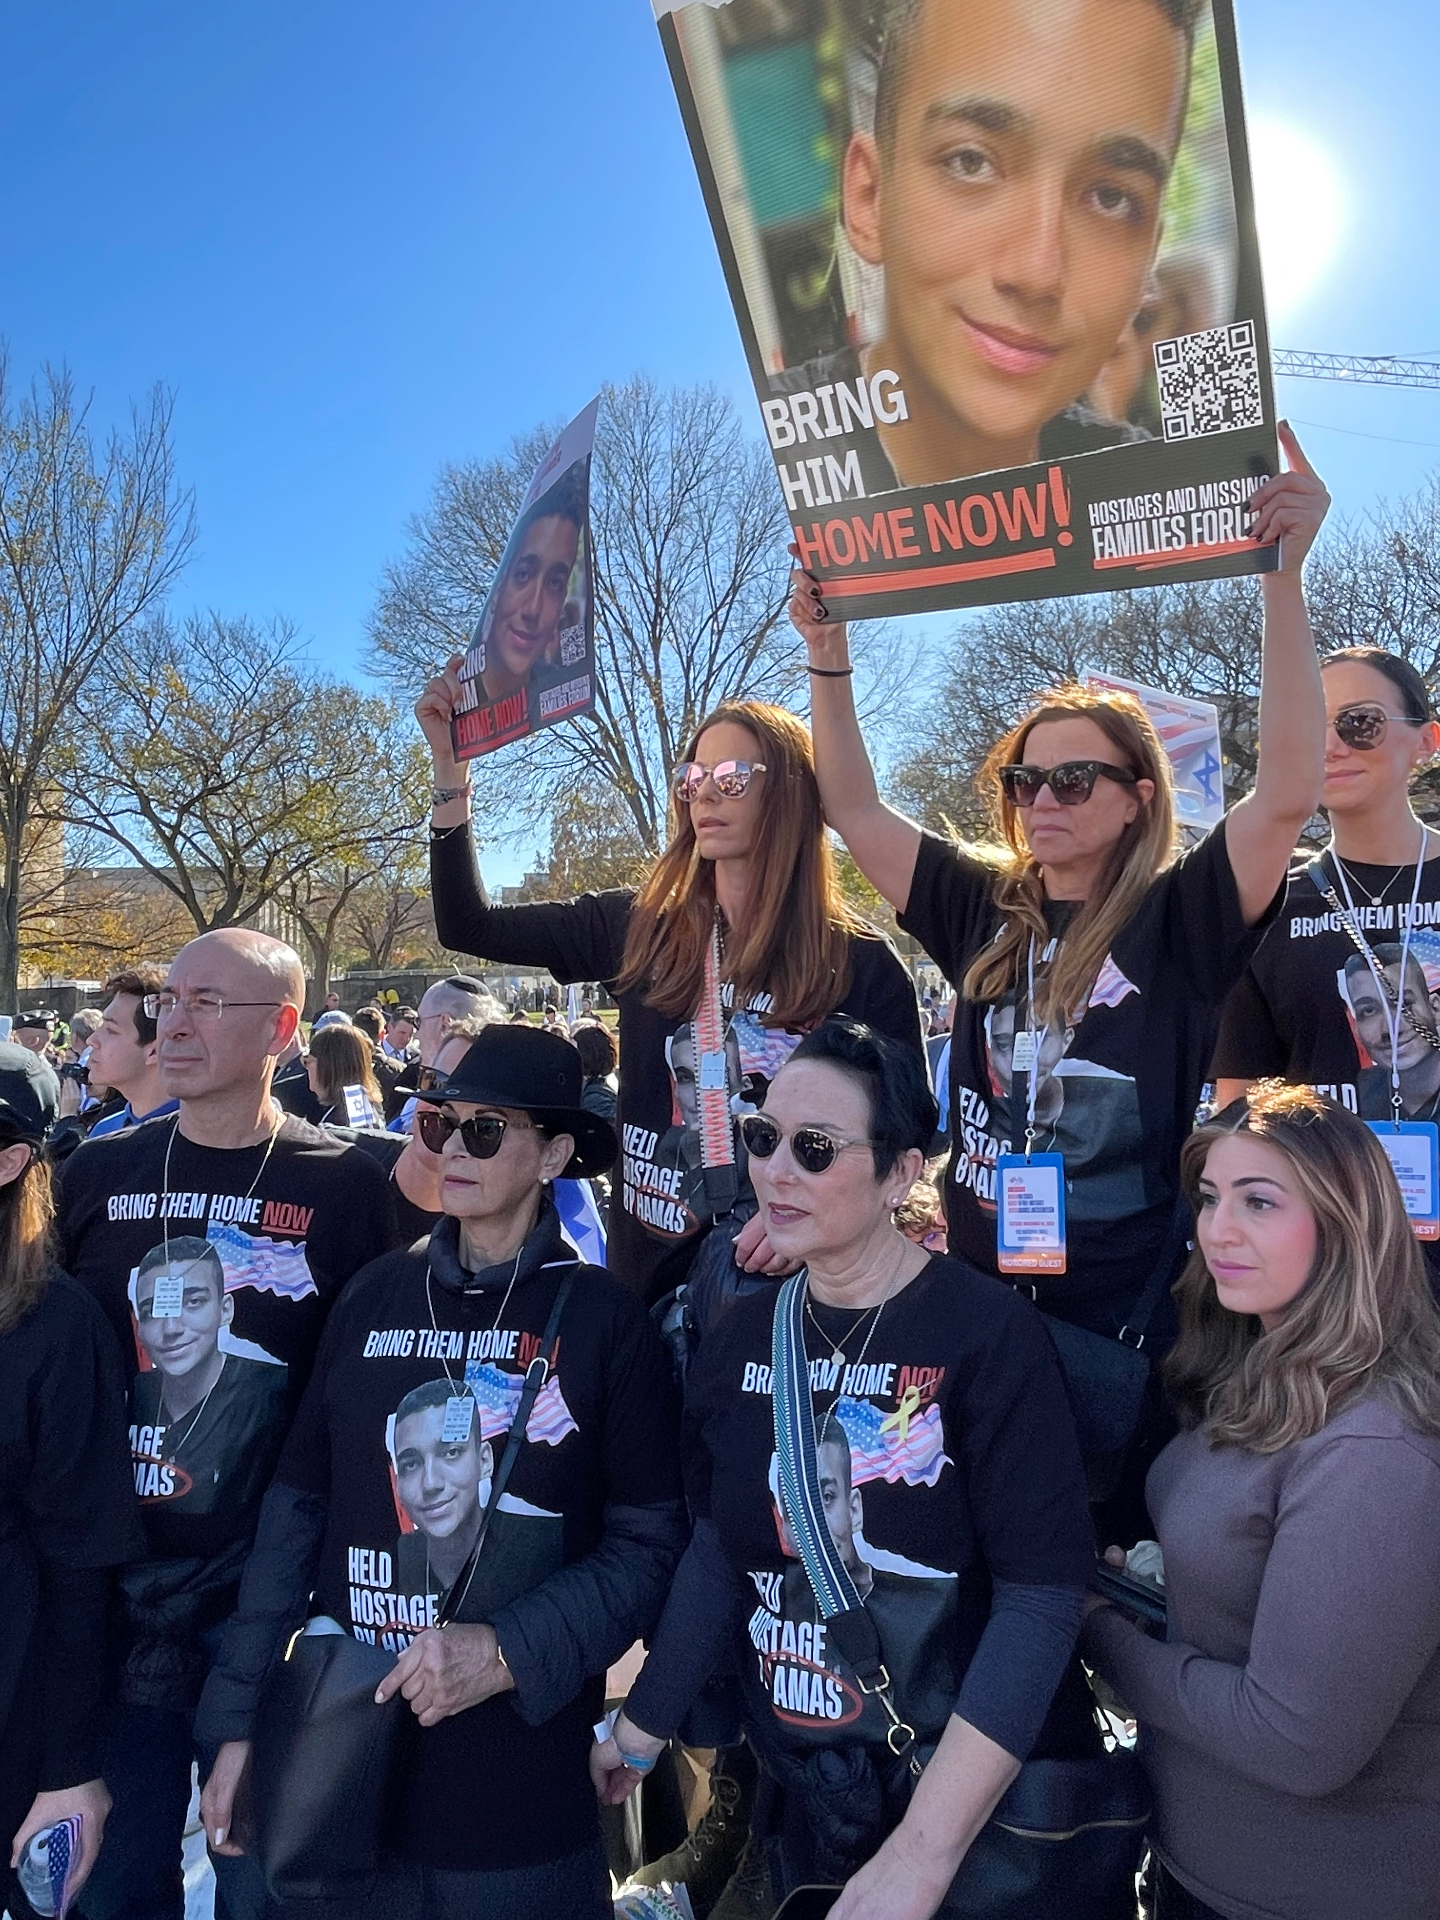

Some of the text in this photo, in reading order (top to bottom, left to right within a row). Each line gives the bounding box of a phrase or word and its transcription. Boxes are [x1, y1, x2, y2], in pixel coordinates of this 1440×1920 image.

[761, 369, 909, 450] BRING
[778, 449, 866, 511] HIM
[795, 466, 1073, 570] HOME NOW!
[1088, 492, 1163, 527] HOSTAGES
[1165, 486, 1197, 515] AND
[1092, 505, 1261, 561] FAMILIES FORU
[457, 643, 486, 682] RING
[455, 679, 479, 716] IM
[456, 686, 529, 746] HOME NOW!
[541, 685, 590, 717] FAMILIES FORUM
[1290, 902, 1440, 939] BRING HEM HOM
[959, 1085, 989, 1129] ELD
[622, 1123, 659, 1161] HELD
[623, 1153, 684, 1200] HOSTAGE
[107, 1192, 315, 1231] BRING THEM HOME NOW
[623, 1182, 688, 1234] BY HAMAS
[1412, 1225, 1436, 1235] UEST
[362, 1330, 416, 1358] BRING
[416, 1329, 464, 1359] THEM
[466, 1330, 520, 1360] HOME
[741, 1361, 773, 1395] BRI
[807, 1358, 840, 1392] HEM
[840, 1362, 897, 1397] HOME
[348, 1546, 392, 1589] HELD
[349, 1586, 439, 1629] HOSTAGE
[748, 1605, 827, 1668] HOSTAGE
[773, 1665, 843, 1720] AMAS
